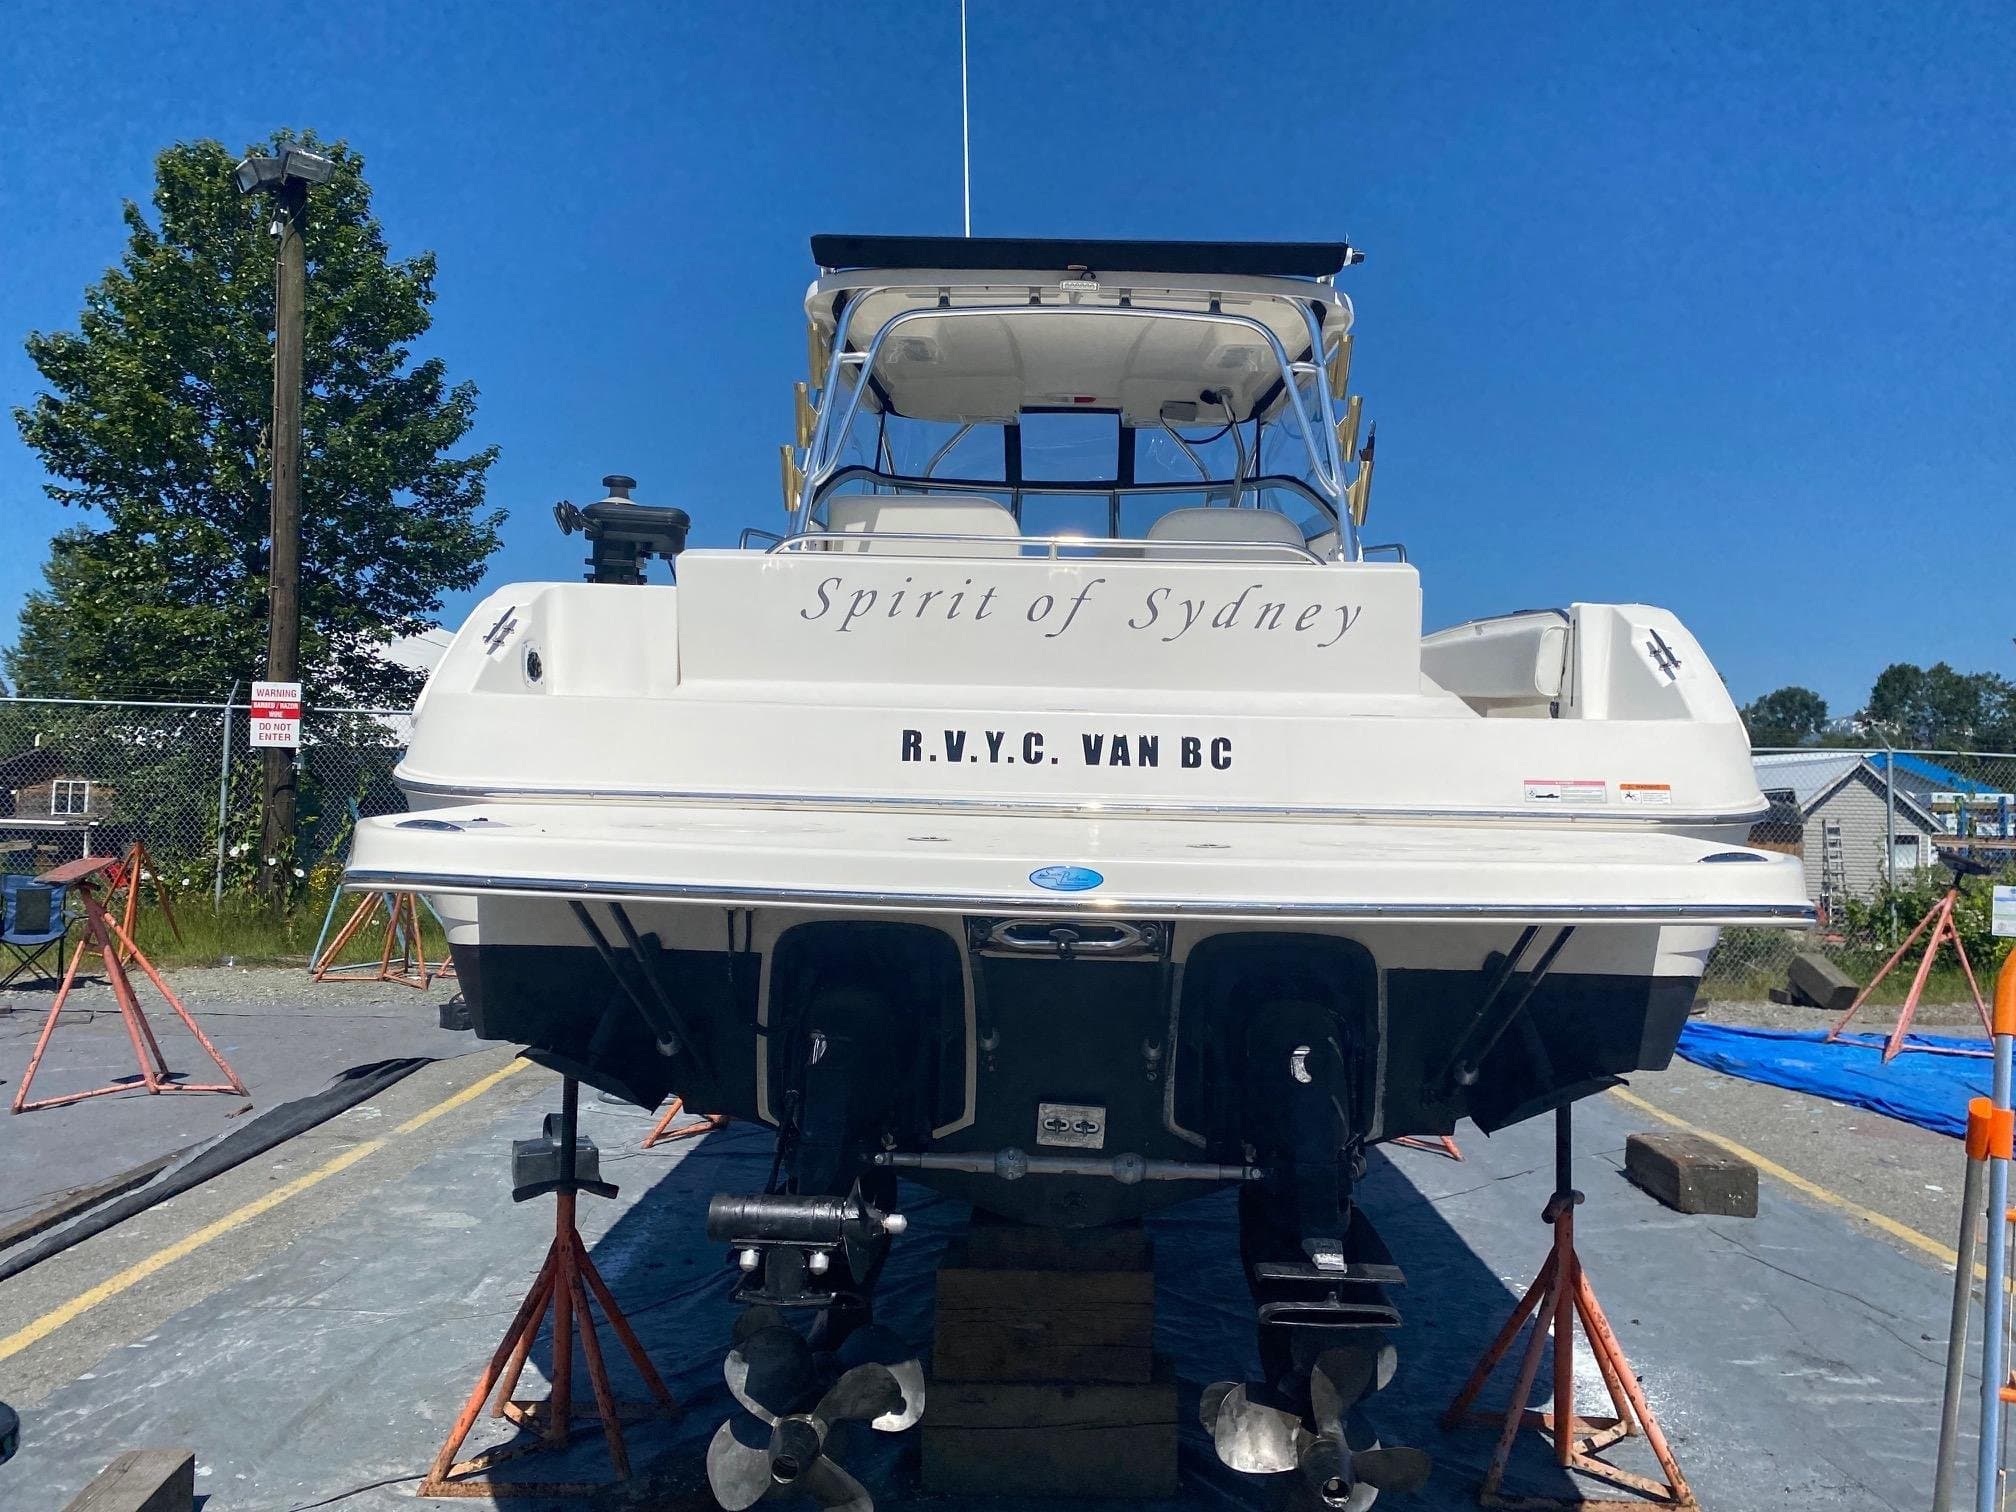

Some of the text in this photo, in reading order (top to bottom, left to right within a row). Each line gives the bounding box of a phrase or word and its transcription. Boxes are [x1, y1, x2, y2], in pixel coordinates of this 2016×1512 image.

[800, 576, 1362, 648] Spirit of Sydney
[256, 688, 297, 698] WARNING
[259, 722, 292, 732] DO NOT
[258, 732, 291, 742] ENTER
[901, 729, 1233, 770] R.V.Y.C. VAN BC
